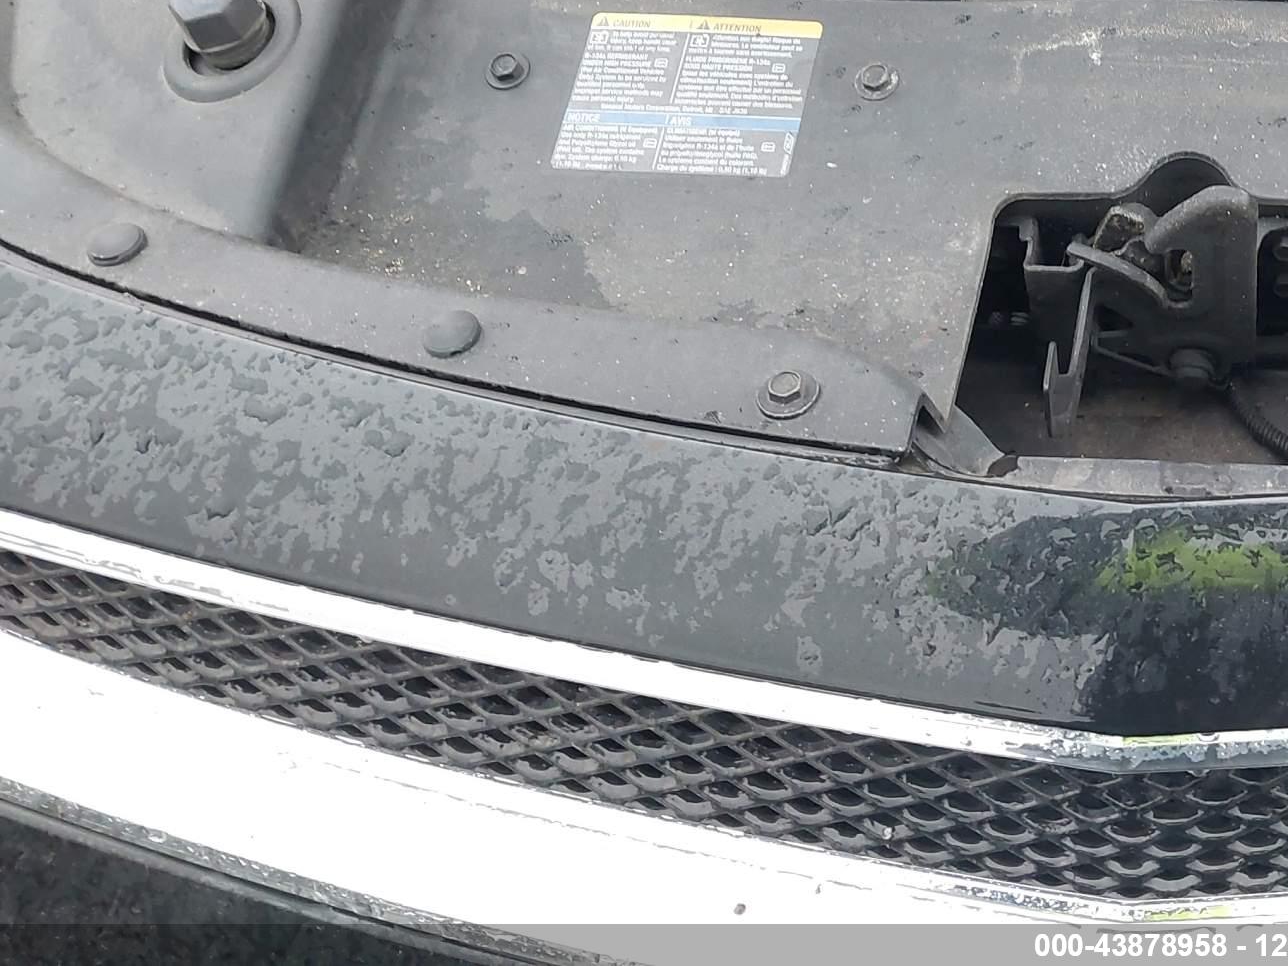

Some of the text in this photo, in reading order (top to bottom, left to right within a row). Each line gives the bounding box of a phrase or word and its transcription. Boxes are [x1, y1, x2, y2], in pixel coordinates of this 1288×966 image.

[613, 20, 651, 28] CAUTION
[713, 23, 762, 32] ATTENTION
[567, 113, 600, 123] NOTICE
[670, 116, 691, 126] AVIS
